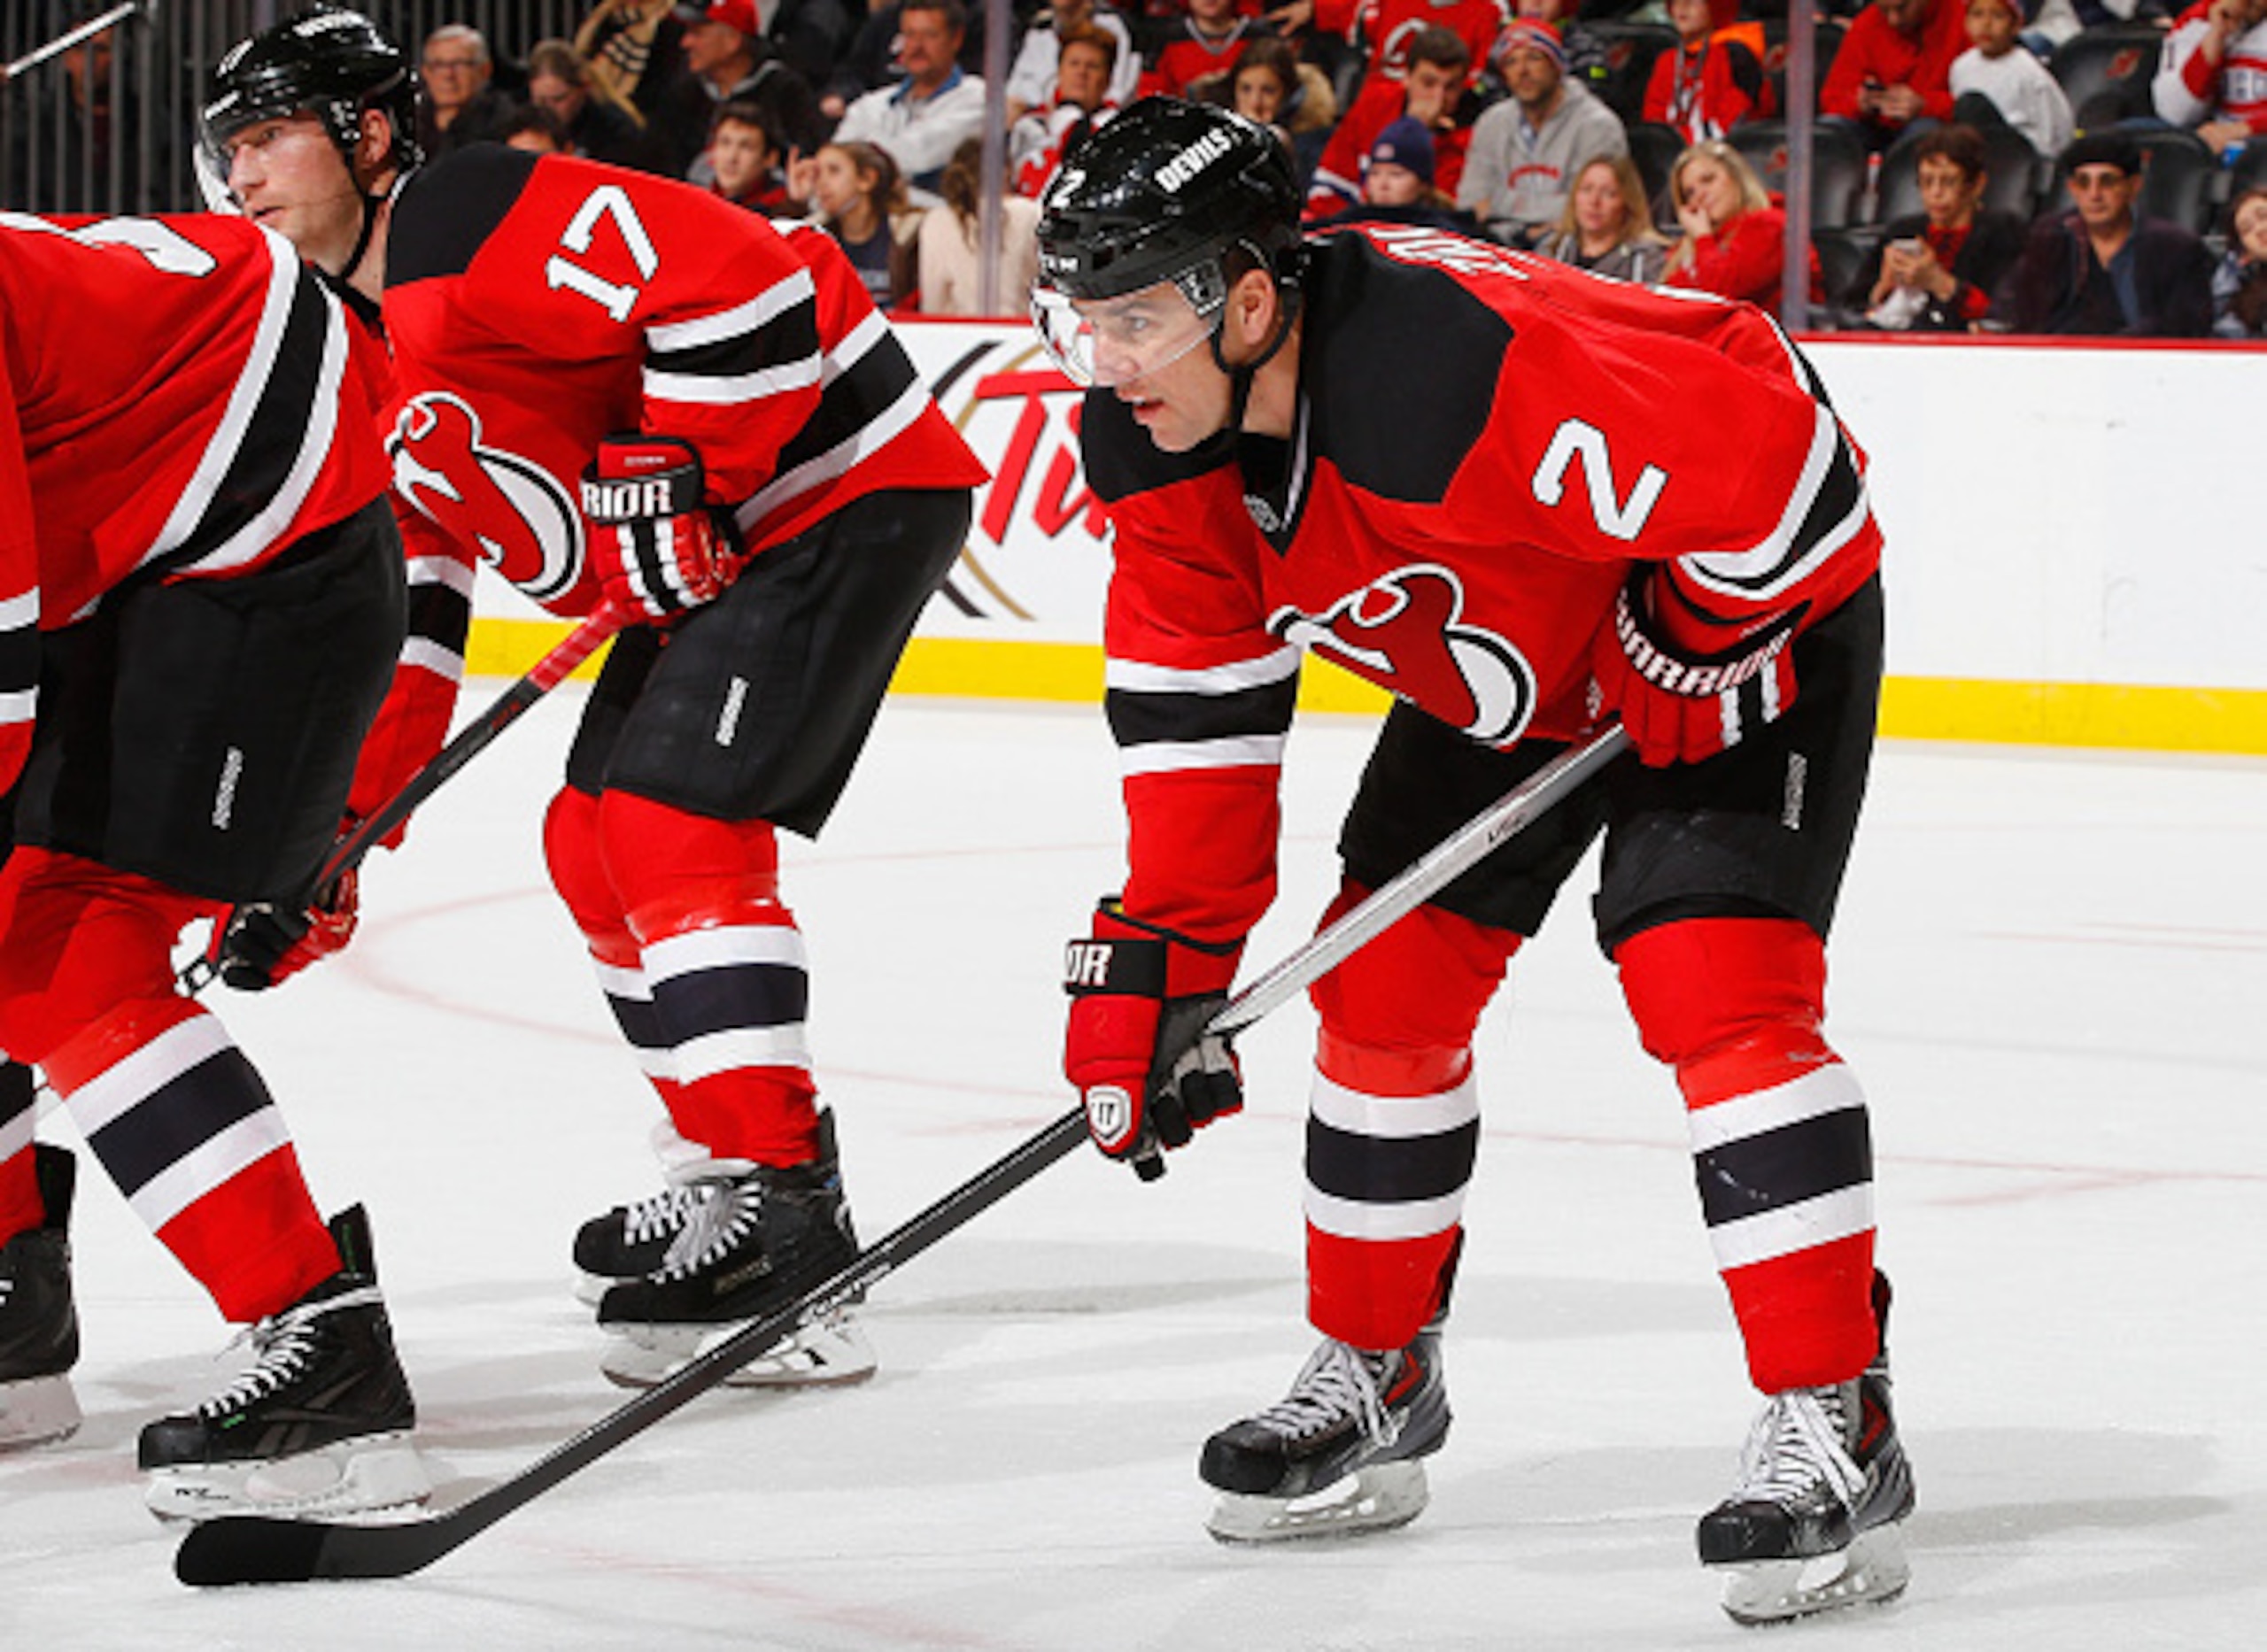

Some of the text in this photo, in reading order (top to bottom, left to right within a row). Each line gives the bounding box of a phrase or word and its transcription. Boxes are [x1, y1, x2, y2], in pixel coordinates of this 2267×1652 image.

[1051, 169, 1087, 208] 2
[1154, 127, 1232, 193] DEVILS
[545, 184, 660, 323] 17
[580, 478, 675, 518] RIOR
[1531, 421, 1671, 542] 2
